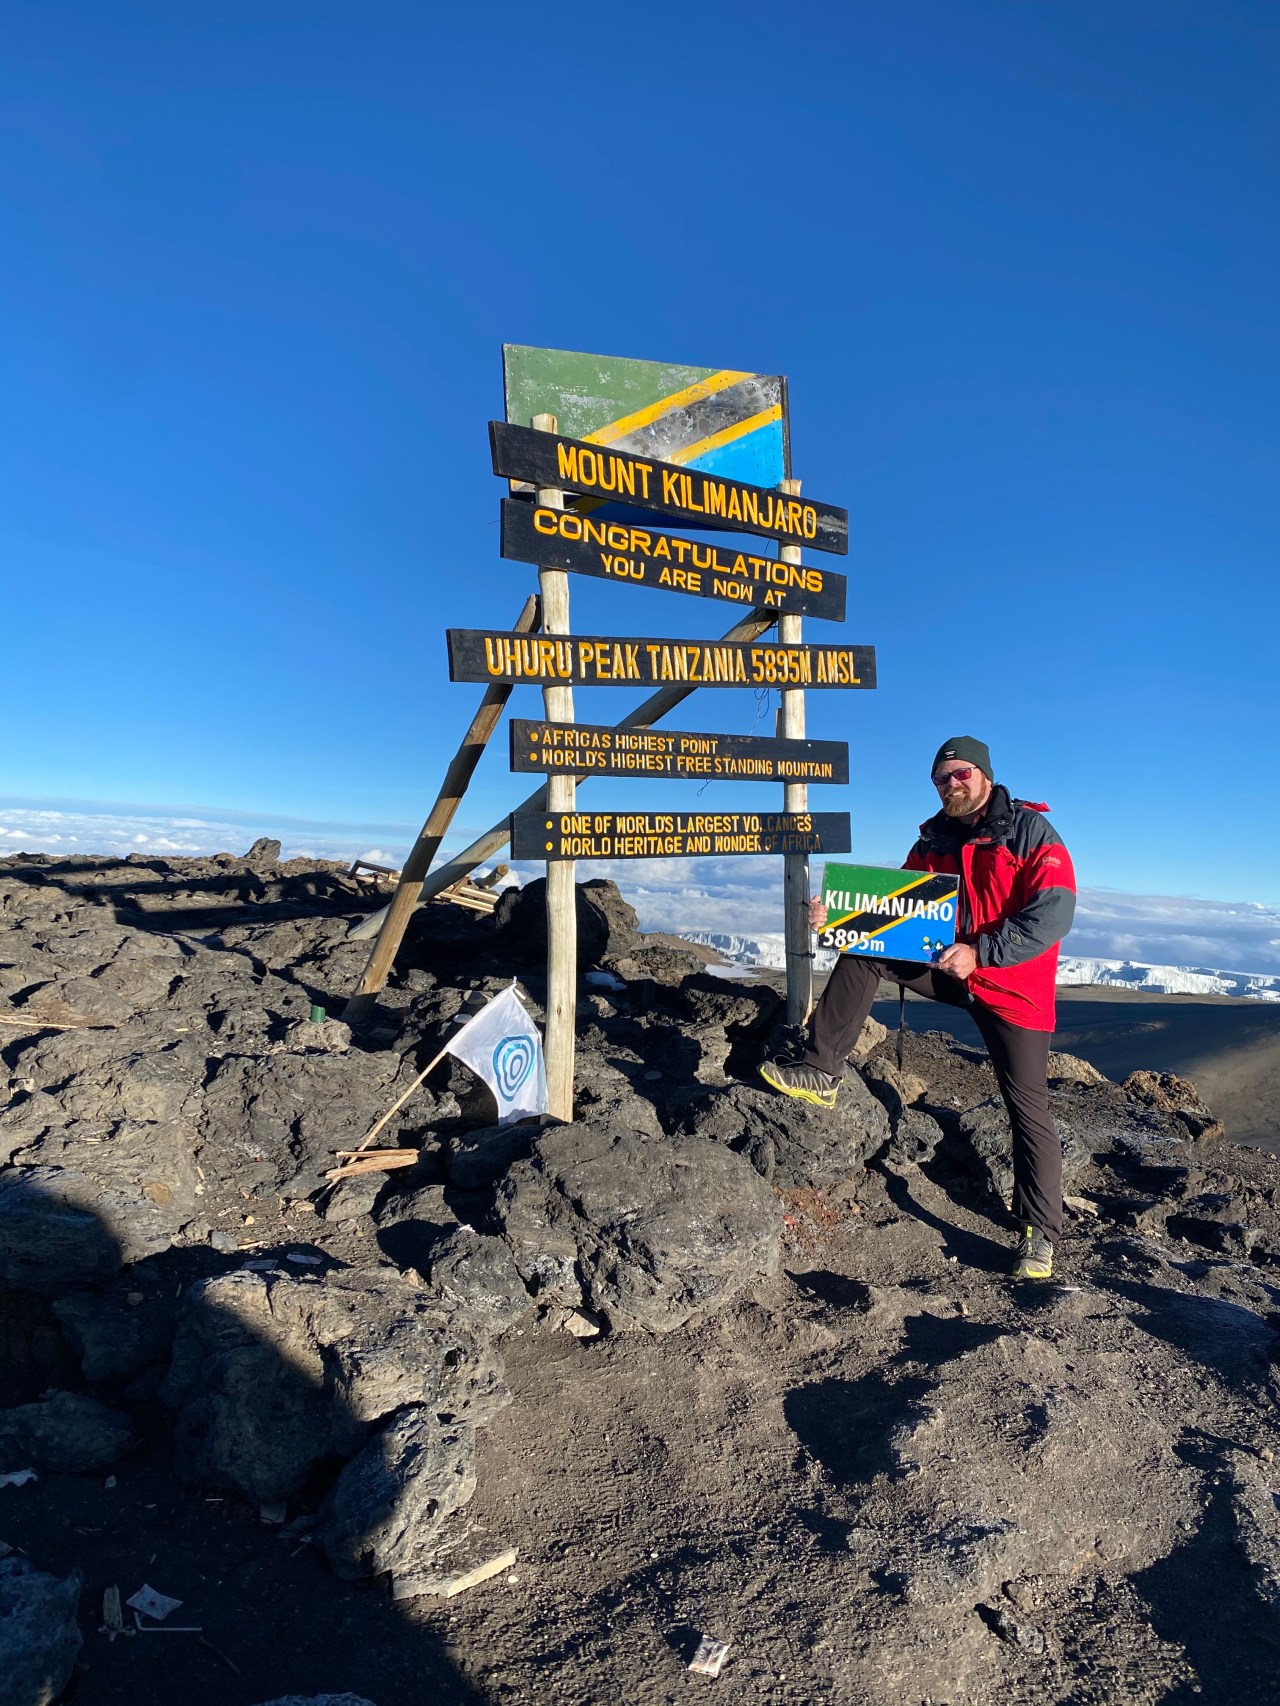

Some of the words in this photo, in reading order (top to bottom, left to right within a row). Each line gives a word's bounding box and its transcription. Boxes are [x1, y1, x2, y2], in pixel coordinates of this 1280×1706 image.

[557, 442, 652, 498] MOUNT
[662, 469, 817, 538] KILIMANJARO
[533, 509, 822, 592] CONGRATULATIONS
[600, 553, 645, 579] YOU
[659, 567, 701, 591] ARE
[713, 579, 753, 601] NOW
[764, 590, 786, 607] AT
[485, 637, 573, 678] UHURU
[578, 642, 641, 679] PEAK
[751, 649, 812, 682] 5895M
[817, 650, 860, 684] AMSL
[542, 729, 611, 748] AFRICAS
[615, 734, 675, 752] HIGHEST
[680, 738, 718, 754] POINT
[541, 748, 606, 767] WORLD'S
[611, 752, 672, 771] HIGHEST
[676, 755, 711, 773] FREE
[714, 758, 773, 775] STANDING
[777, 761, 832, 777] MOUNTAIN
[561, 815, 591, 834] ONE
[594, 815, 612, 834] OF
[616, 816, 674, 834] WORLD'S
[677, 815, 739, 833] LARGEST
[560, 836, 611, 855] WORLD
[614, 836, 682, 855] HERITAGE
[686, 836, 711, 853] AND
[715, 835, 761, 852] WONDER
[764, 835, 778, 851] OF
[782, 834, 821, 850] AFRICA
[825, 889, 953, 922] KILIMANJARO
[823, 927, 885, 953] 5895m
